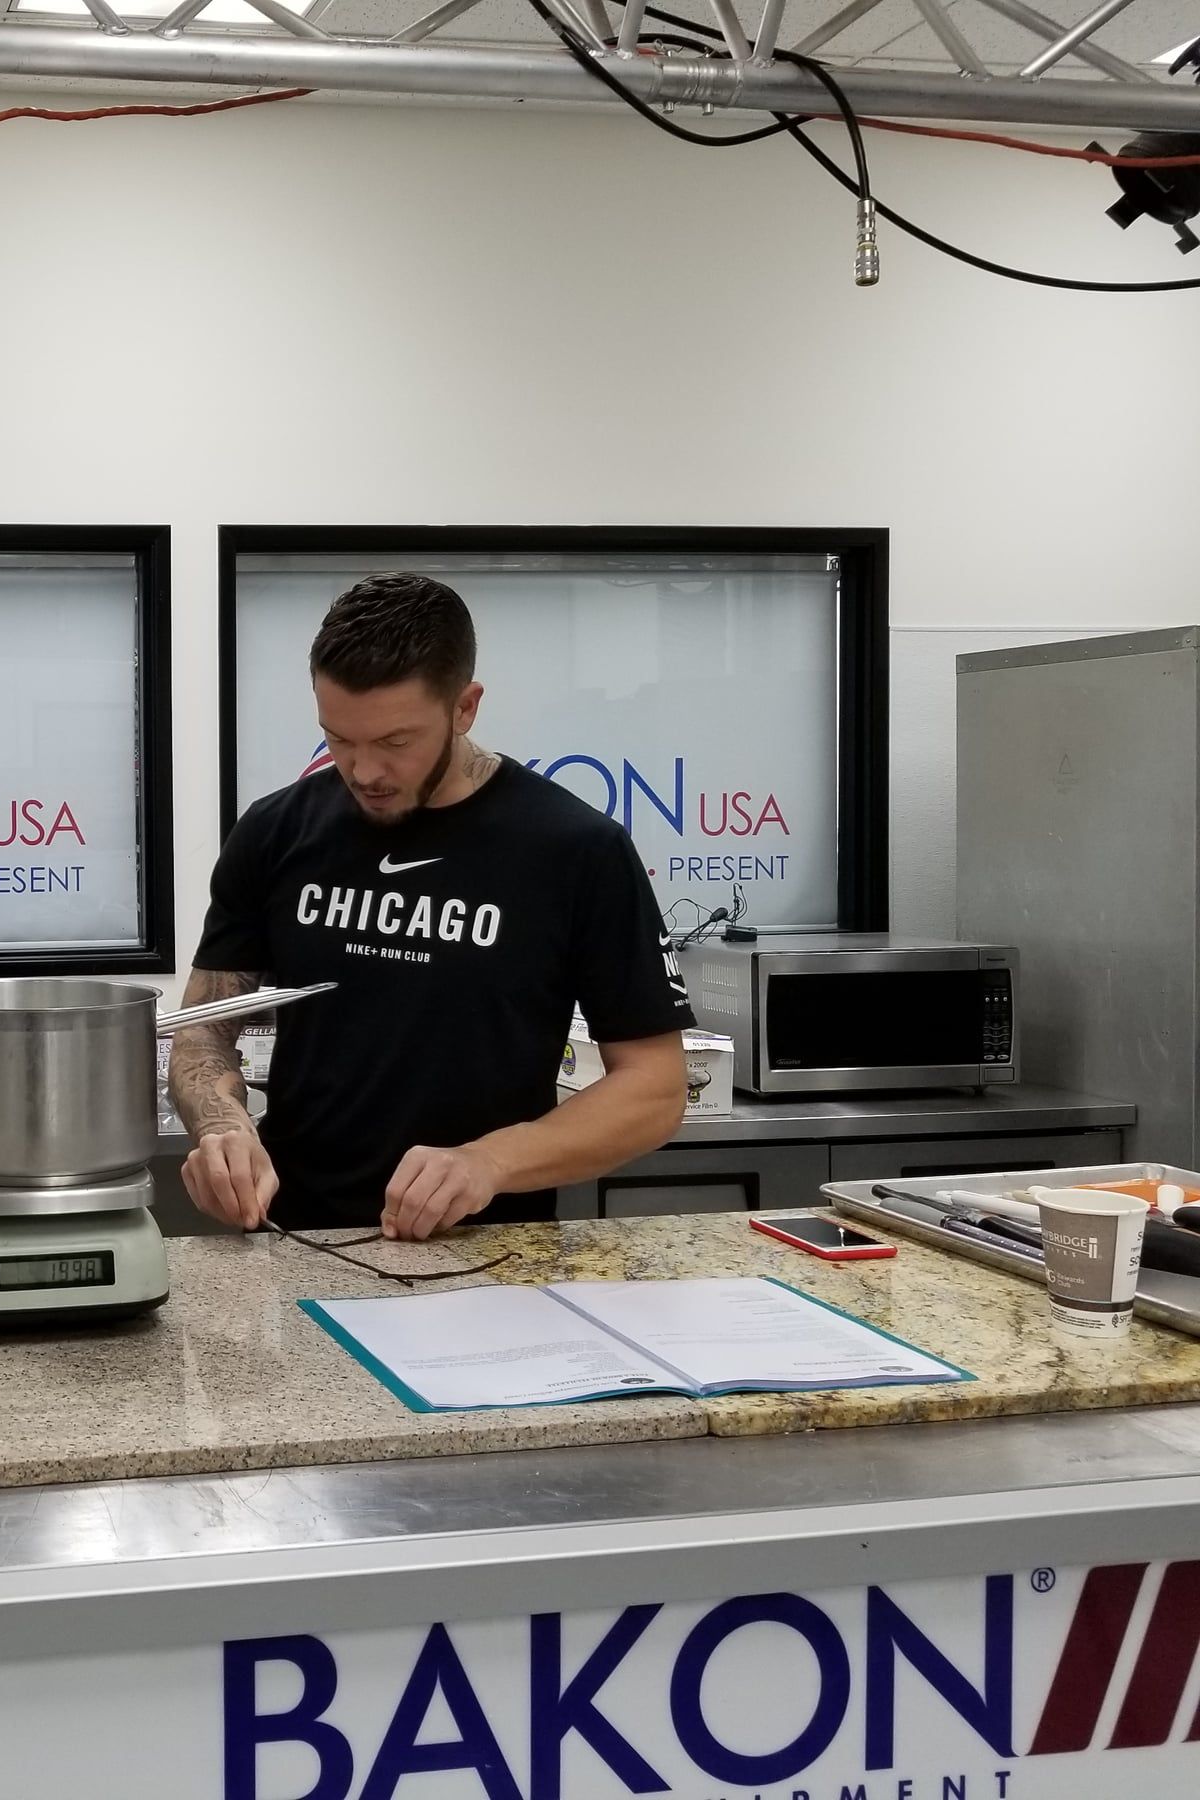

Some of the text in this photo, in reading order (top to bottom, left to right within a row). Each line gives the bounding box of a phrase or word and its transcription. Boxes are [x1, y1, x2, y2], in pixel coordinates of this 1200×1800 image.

[699, 791, 791, 837] USA
[669, 855, 790, 882] PRESENT
[296, 883, 501, 947] CHICAGO
[345, 942, 431, 963] NIKE+ RUN CLUB
[223, 1573, 1020, 1800] BAKON
